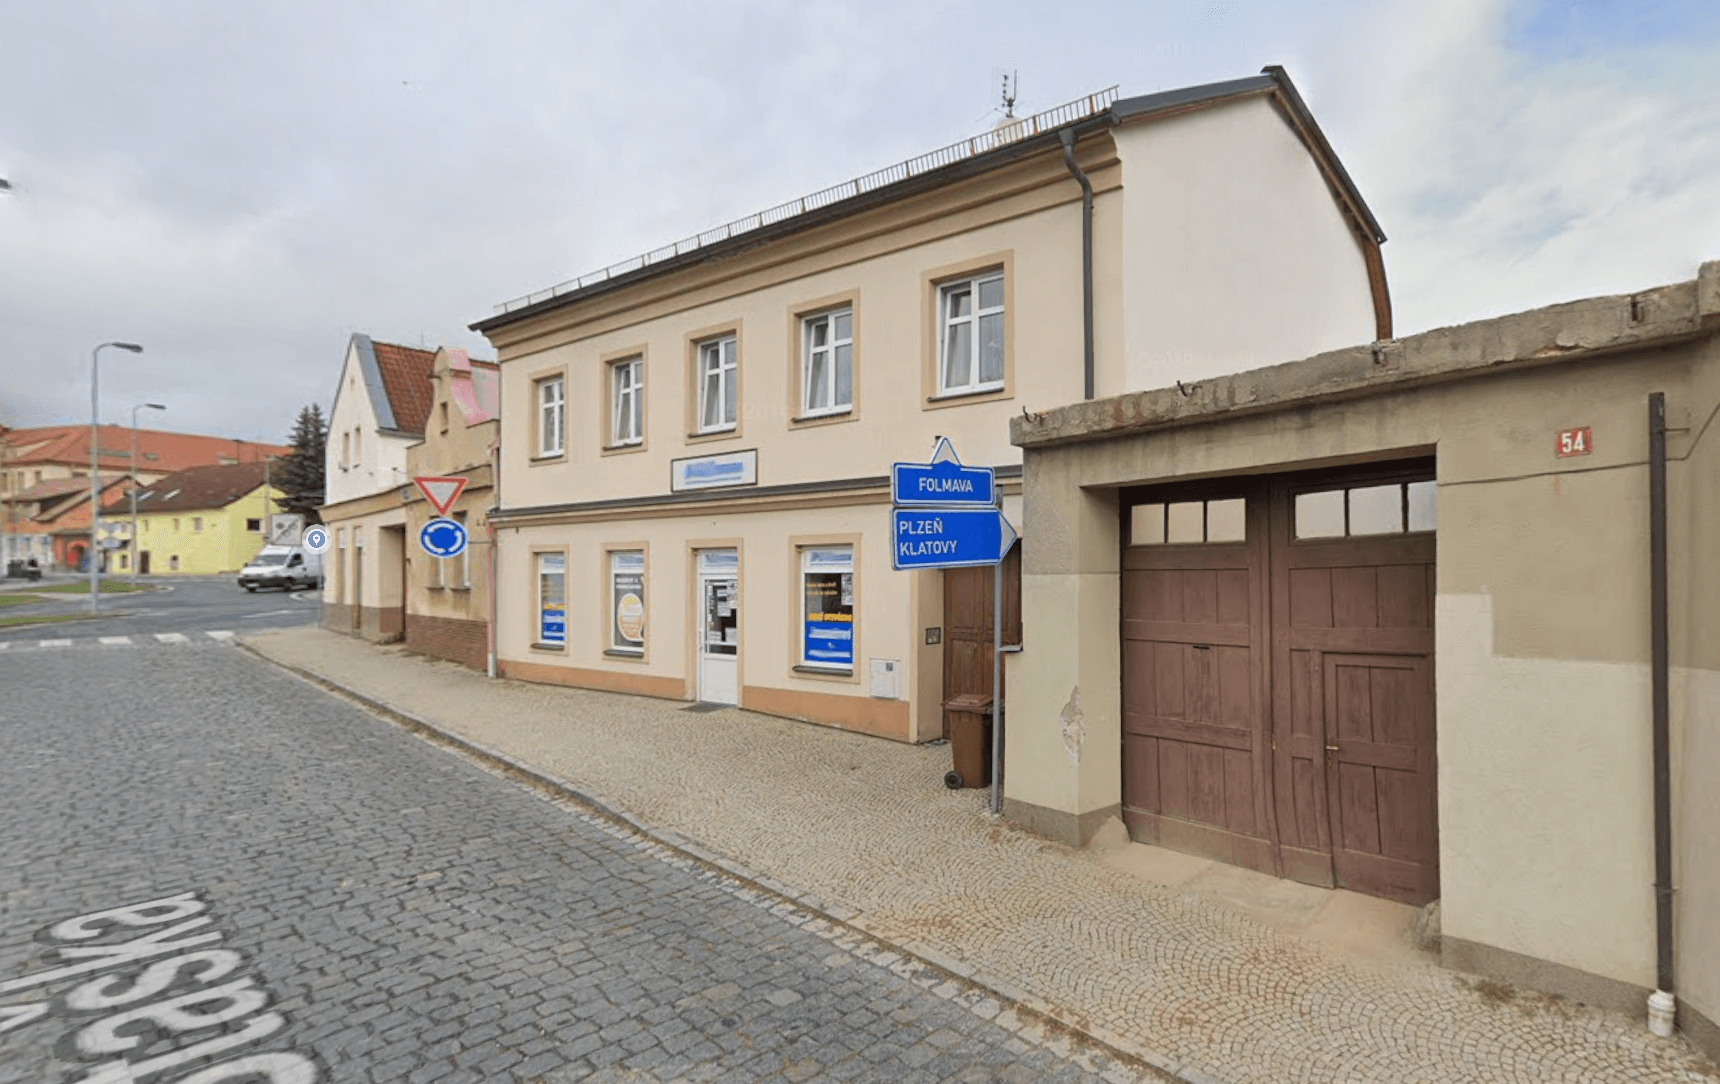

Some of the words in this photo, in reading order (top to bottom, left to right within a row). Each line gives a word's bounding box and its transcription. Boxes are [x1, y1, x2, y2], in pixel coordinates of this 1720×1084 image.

[1561, 430, 1584, 453] 54
[918, 477, 974, 493] FOLMAVA
[899, 517, 944, 535] PLZEŇ
[899, 540, 957, 557] KLATOVY
